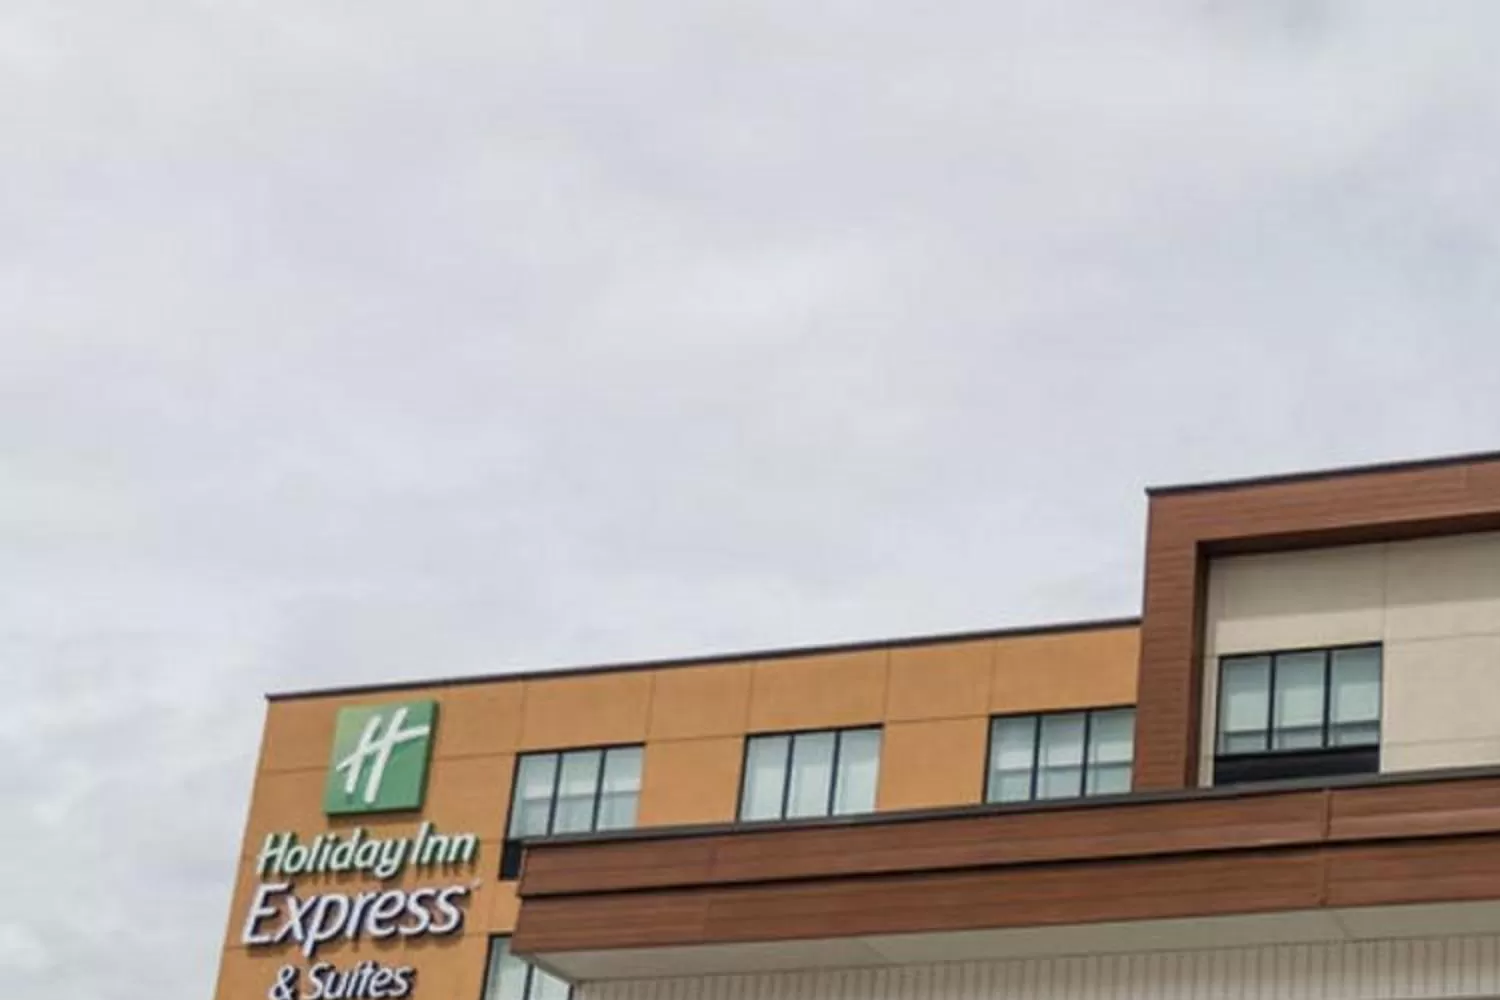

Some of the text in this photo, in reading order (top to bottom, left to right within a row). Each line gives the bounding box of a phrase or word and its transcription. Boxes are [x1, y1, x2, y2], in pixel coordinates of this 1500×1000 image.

[336, 707, 431, 804] H
[256, 822, 477, 879] Holiday Inn
[241, 882, 470, 958] Express
